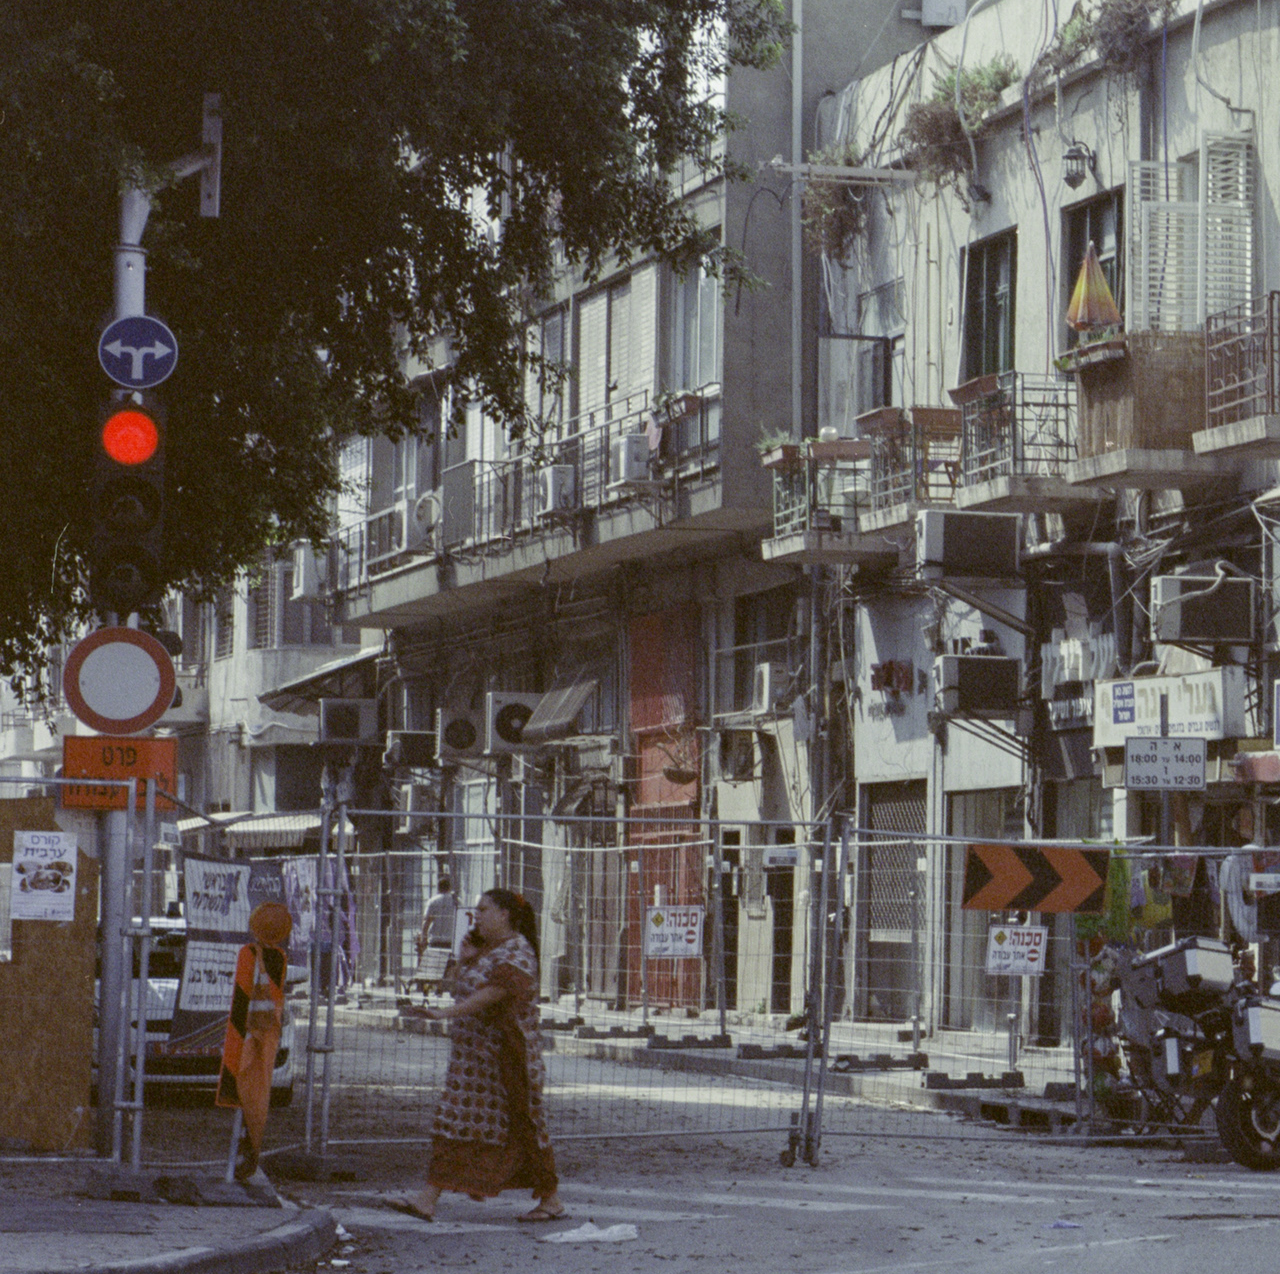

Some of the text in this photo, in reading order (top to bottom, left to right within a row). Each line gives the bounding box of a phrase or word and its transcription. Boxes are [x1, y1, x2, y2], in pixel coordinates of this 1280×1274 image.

[1150, 742, 1158, 751] ה
[1174, 742, 1182, 751] א
[102, 746, 137, 767] פרט
[1130, 754, 1158, 764] 18:00
[1174, 754, 1202, 764] 14:00
[1131, 775, 1158, 785] 15:30
[1174, 775, 1201, 785] 12:30
[31, 834, 61, 846] קורס
[23, 847, 67, 858] ערבית
[666, 910, 699, 927] סכנה!
[1009, 929, 1043, 946] סכנה!
